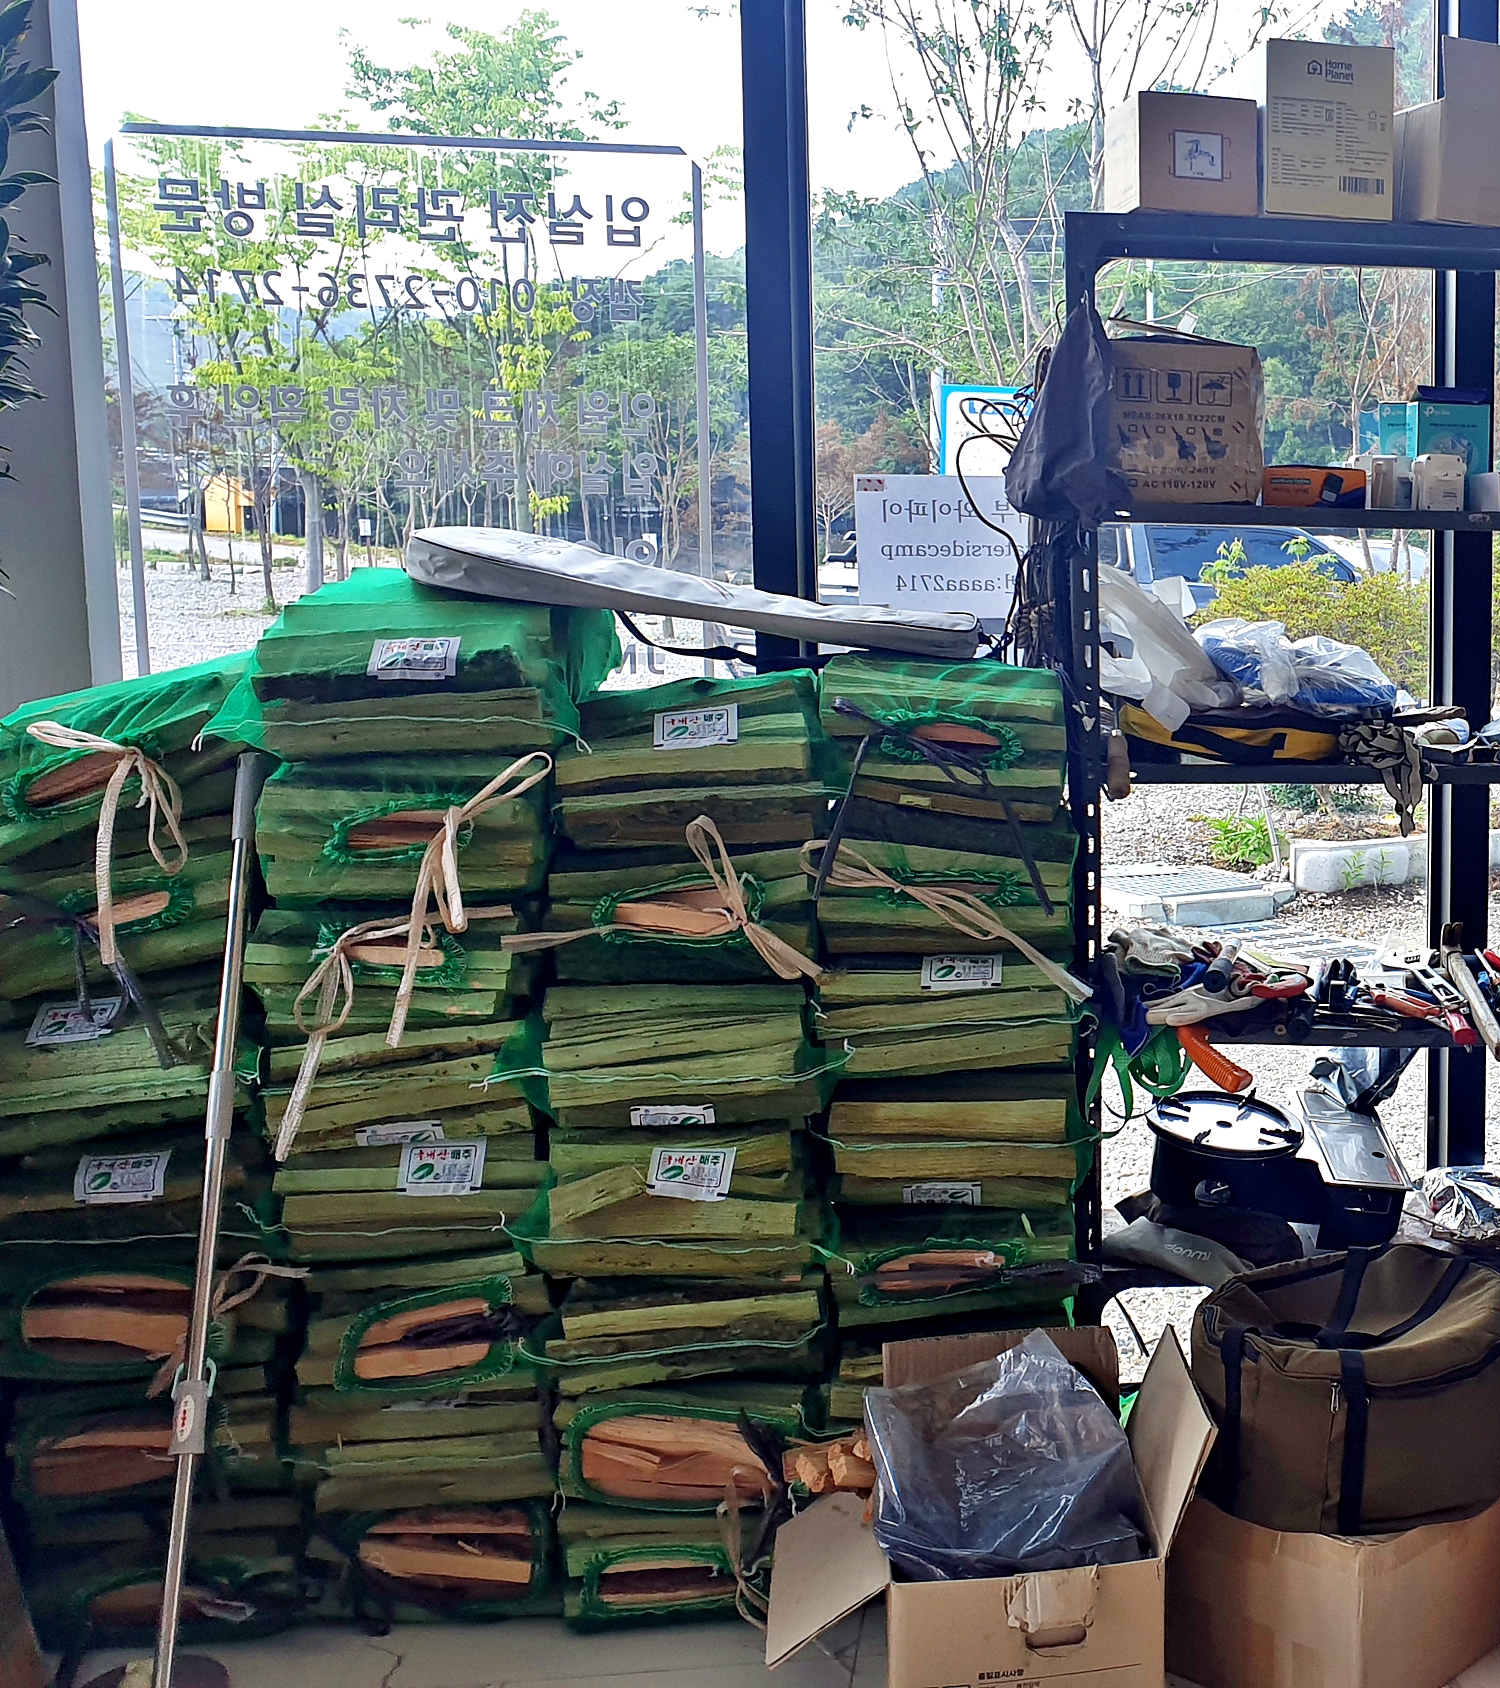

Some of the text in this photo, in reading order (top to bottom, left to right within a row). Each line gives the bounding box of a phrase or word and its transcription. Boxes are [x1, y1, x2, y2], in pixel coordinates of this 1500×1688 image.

[1325, 59, 1353, 70] Home
[1325, 70, 1354, 82] Planet
[414, 1148, 473, 1160] 국내산 배추
[699, 1154, 721, 1166] 배추
